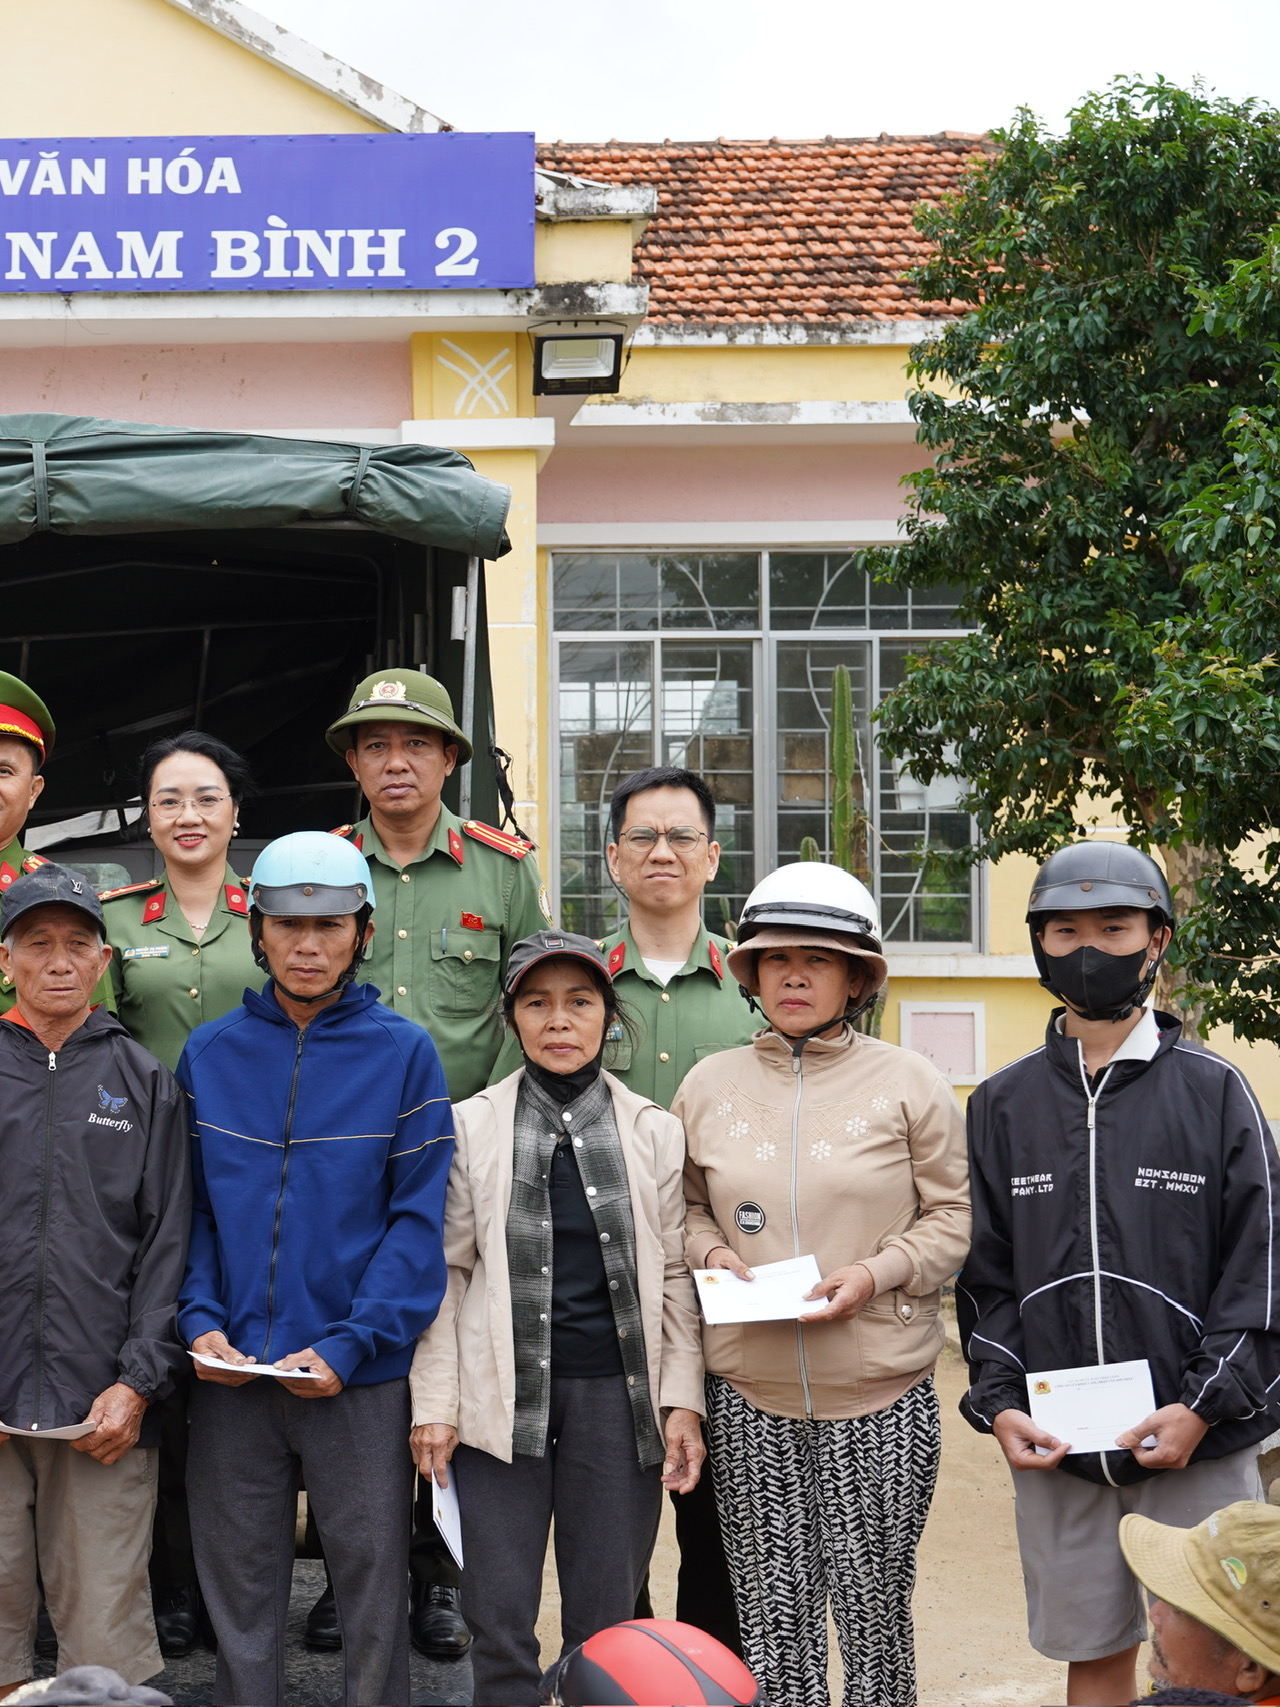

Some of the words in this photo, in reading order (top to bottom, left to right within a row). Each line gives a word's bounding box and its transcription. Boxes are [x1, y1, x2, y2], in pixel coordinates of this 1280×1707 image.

[127, 147, 242, 196] HÓA
[4, 231, 184, 281] NAM
[210, 215, 406, 279] BÌNH
[434, 227, 480, 277] 2
[87, 1112, 134, 1133] Butterfly
[1137, 1166, 1206, 1186] NOWSAIGON
